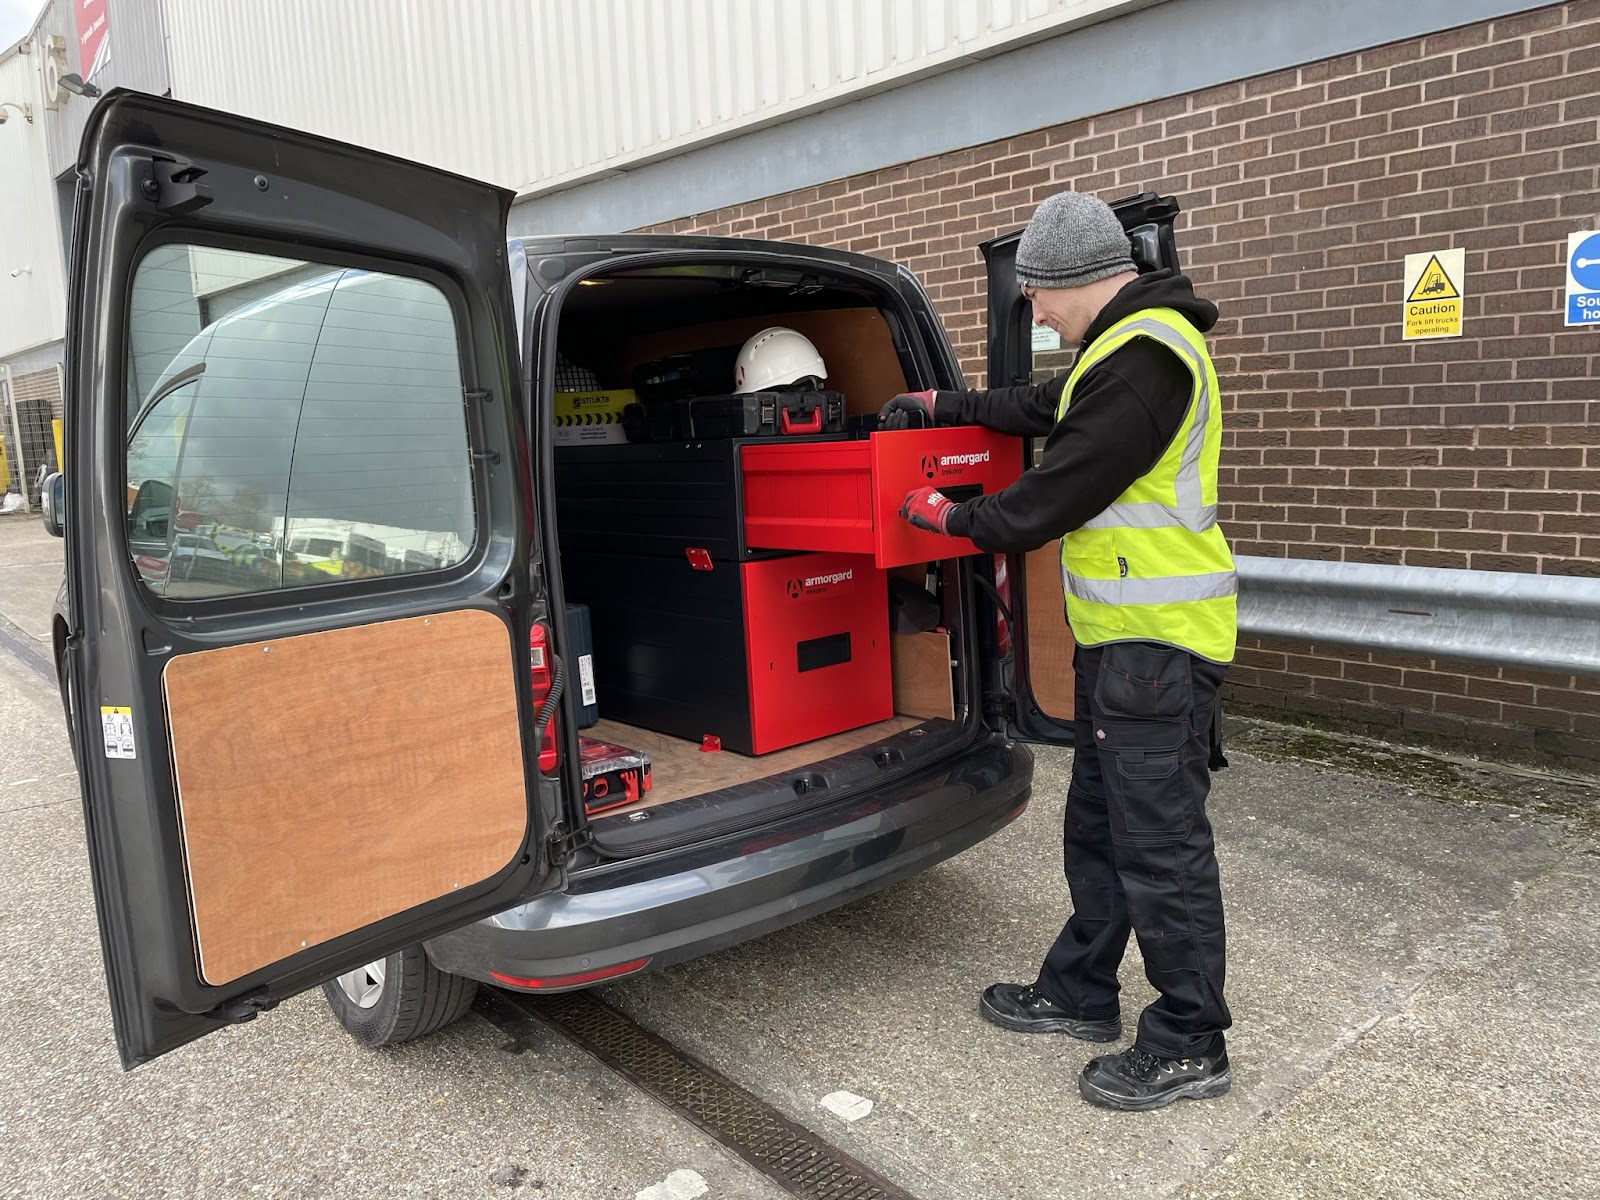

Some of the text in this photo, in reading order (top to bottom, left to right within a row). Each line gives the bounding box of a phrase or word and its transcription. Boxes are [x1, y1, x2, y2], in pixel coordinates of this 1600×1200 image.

[83, 25, 93, 44] goods
[45, 34, 63, 103] 6
[1410, 304, 1456, 316] Caution
[1414, 326, 1449, 335] operating
[582, 396, 610, 404] strukta
[941, 450, 989, 466] armorgard
[805, 569, 853, 586] armorgard
